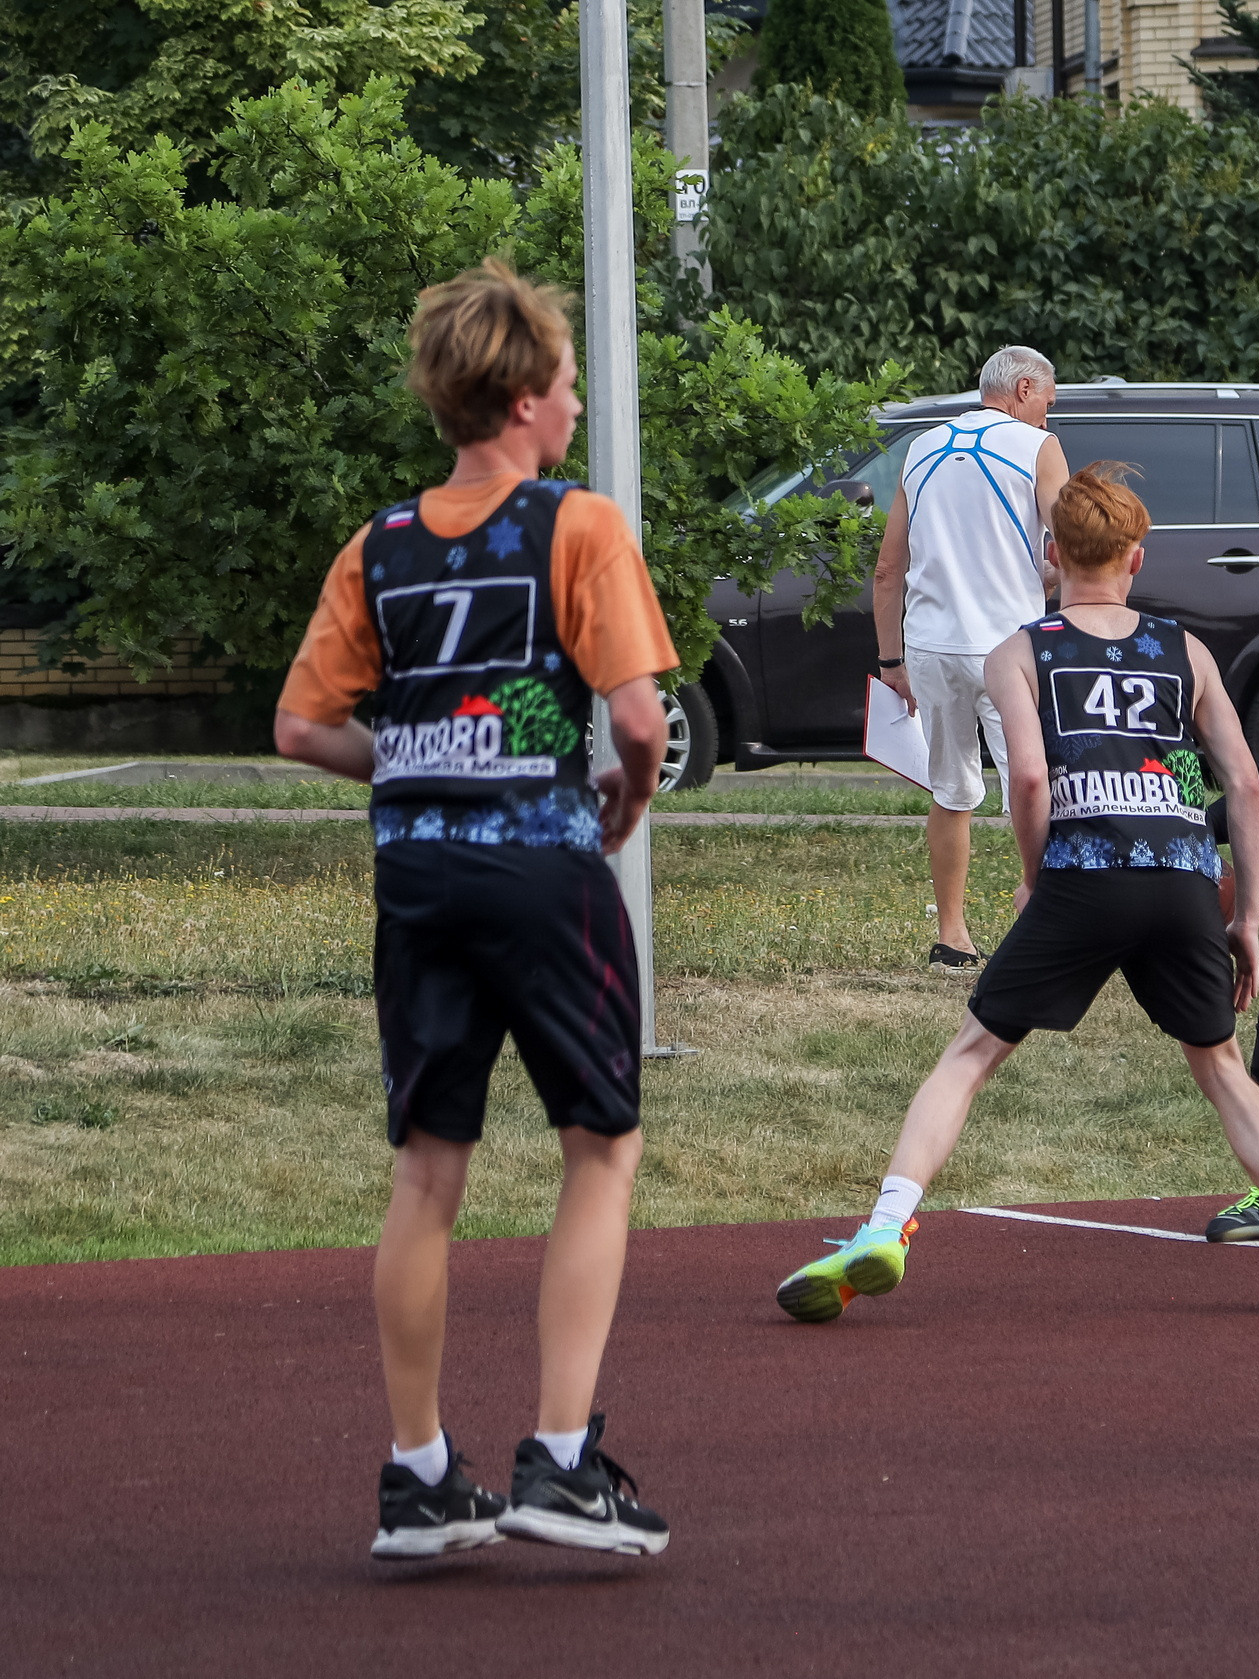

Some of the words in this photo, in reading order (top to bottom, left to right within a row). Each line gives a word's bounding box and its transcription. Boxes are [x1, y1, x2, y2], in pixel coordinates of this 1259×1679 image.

[433, 589, 473, 664] 7
[1083, 674, 1157, 731] 42
[1080, 803, 1161, 816] маленькая
